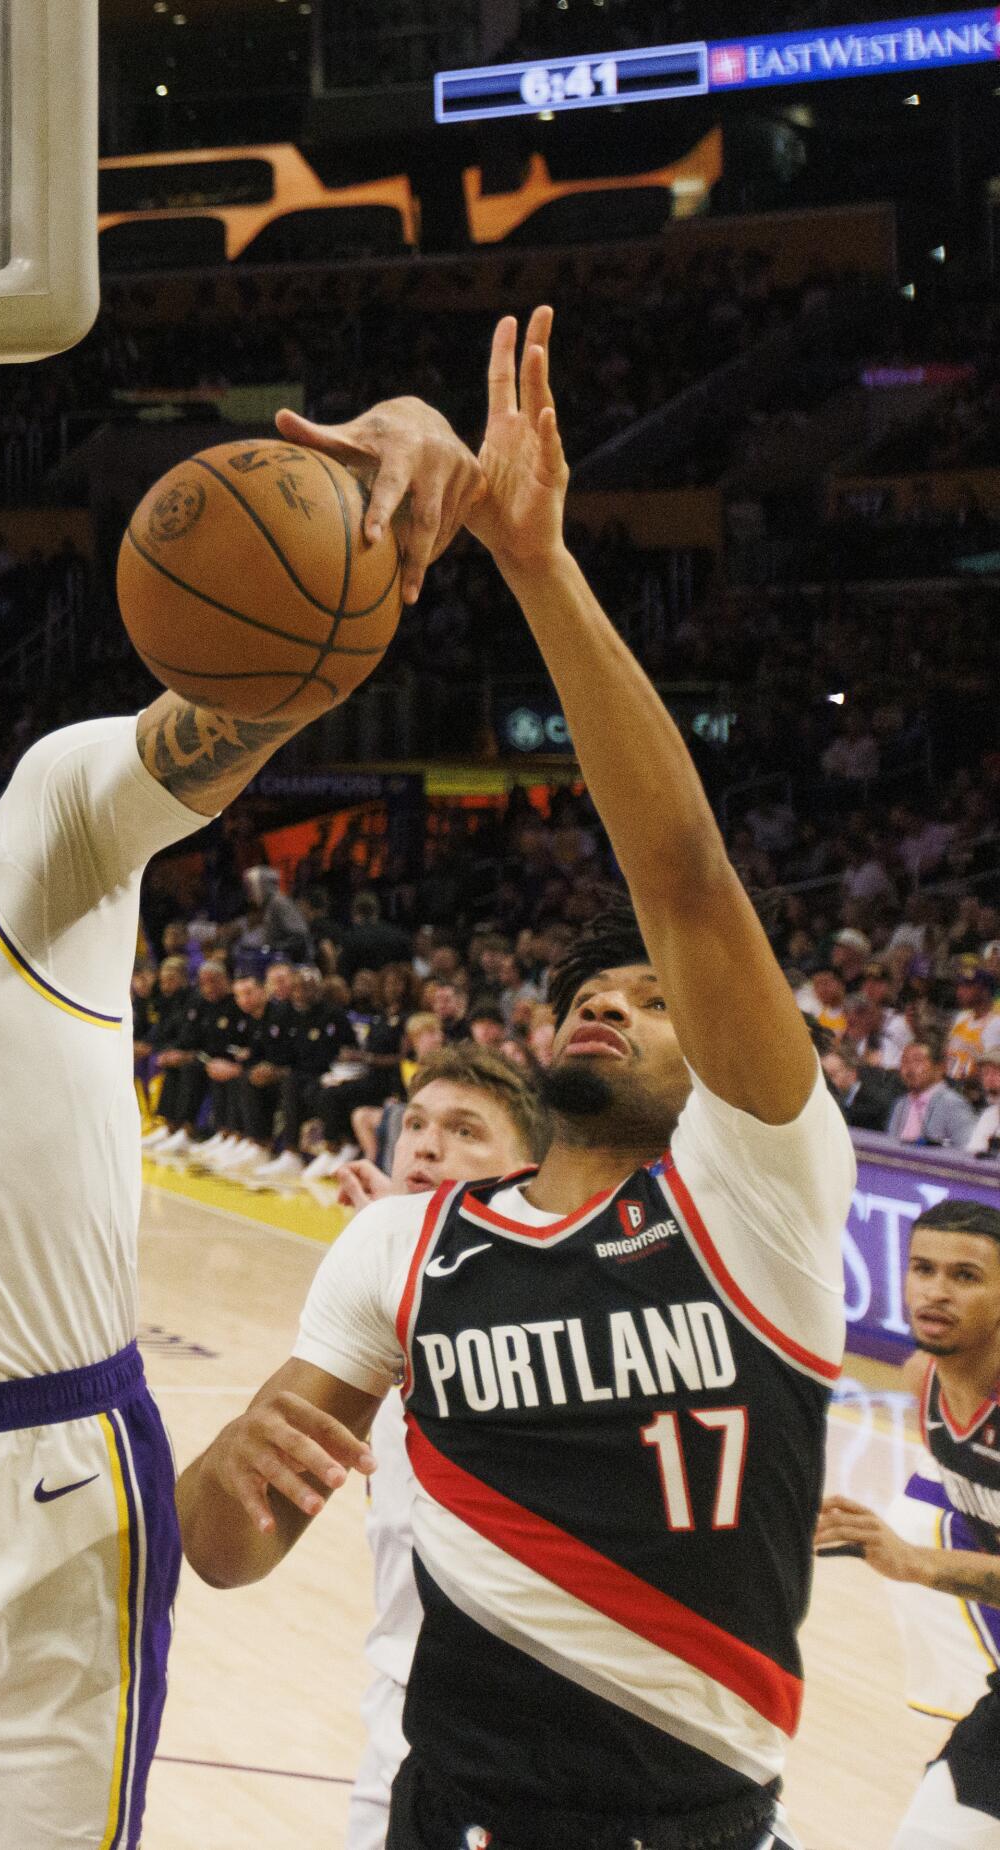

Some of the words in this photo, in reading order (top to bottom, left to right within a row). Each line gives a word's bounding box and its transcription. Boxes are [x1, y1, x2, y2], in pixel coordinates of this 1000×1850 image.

[520, 58, 618, 106] 6:41
[595, 1219, 680, 1258] BRIGHTSIDE
[416, 1301, 737, 1418] PORTLAND
[640, 1405, 748, 1532] 17
